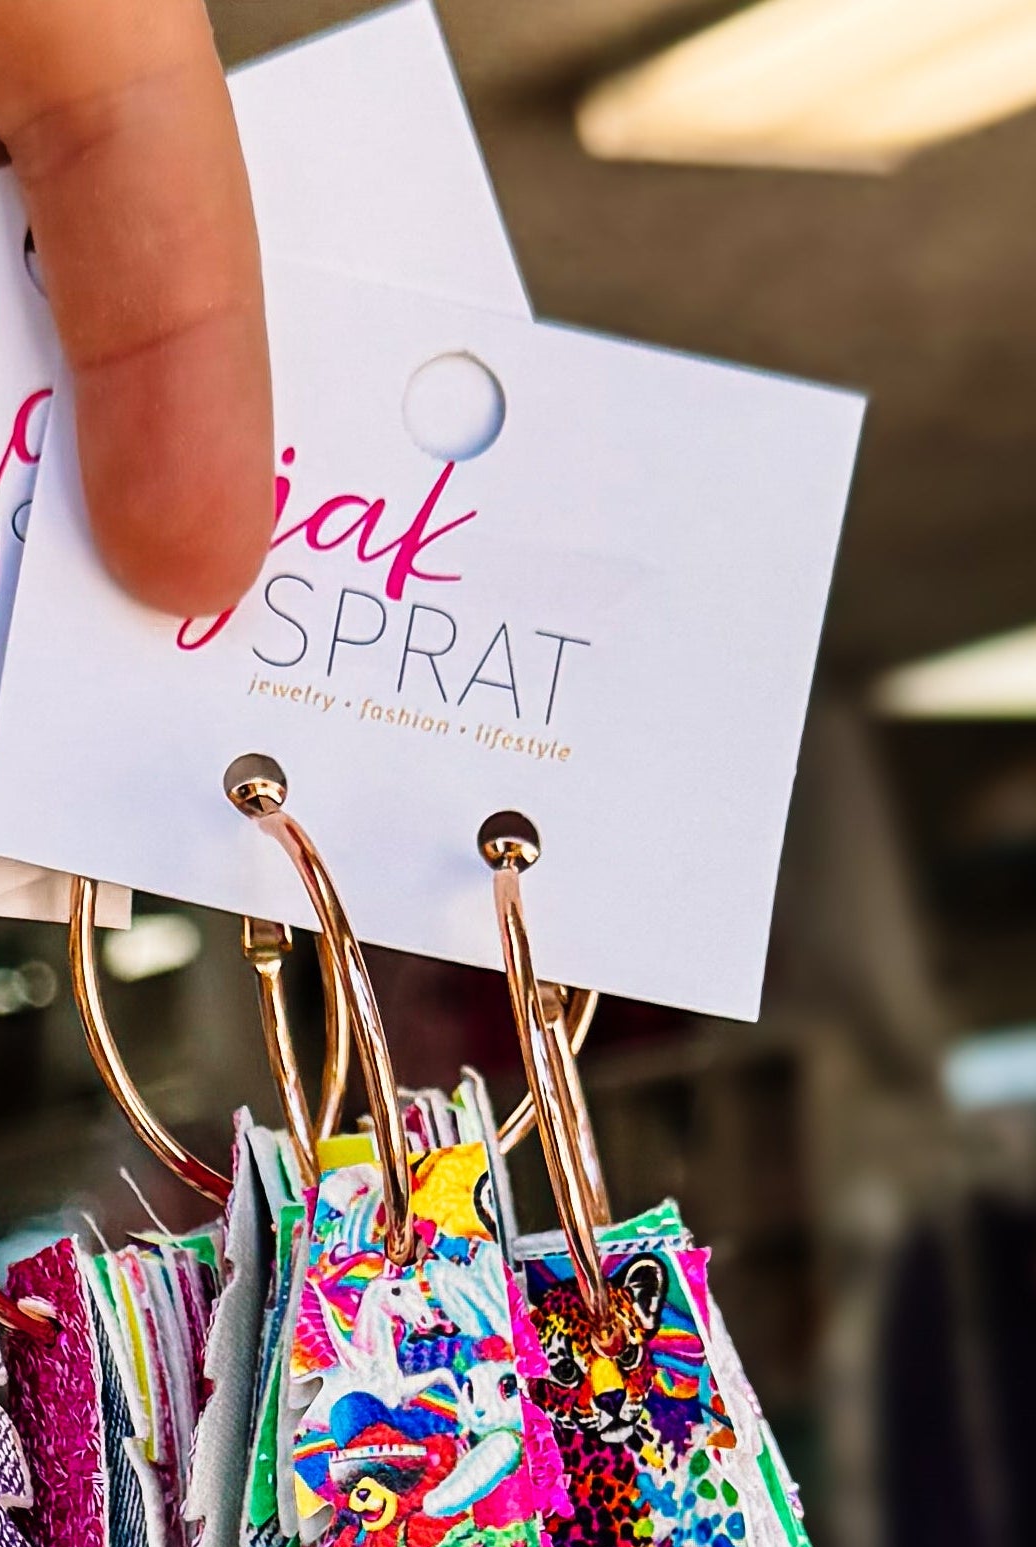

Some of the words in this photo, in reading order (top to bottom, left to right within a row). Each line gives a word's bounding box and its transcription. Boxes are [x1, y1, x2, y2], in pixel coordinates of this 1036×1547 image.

[252, 574, 591, 725] SPRAT
[247, 674, 336, 712] jewelry
[359, 698, 449, 736] fashion
[474, 723, 573, 762] lifestyle
